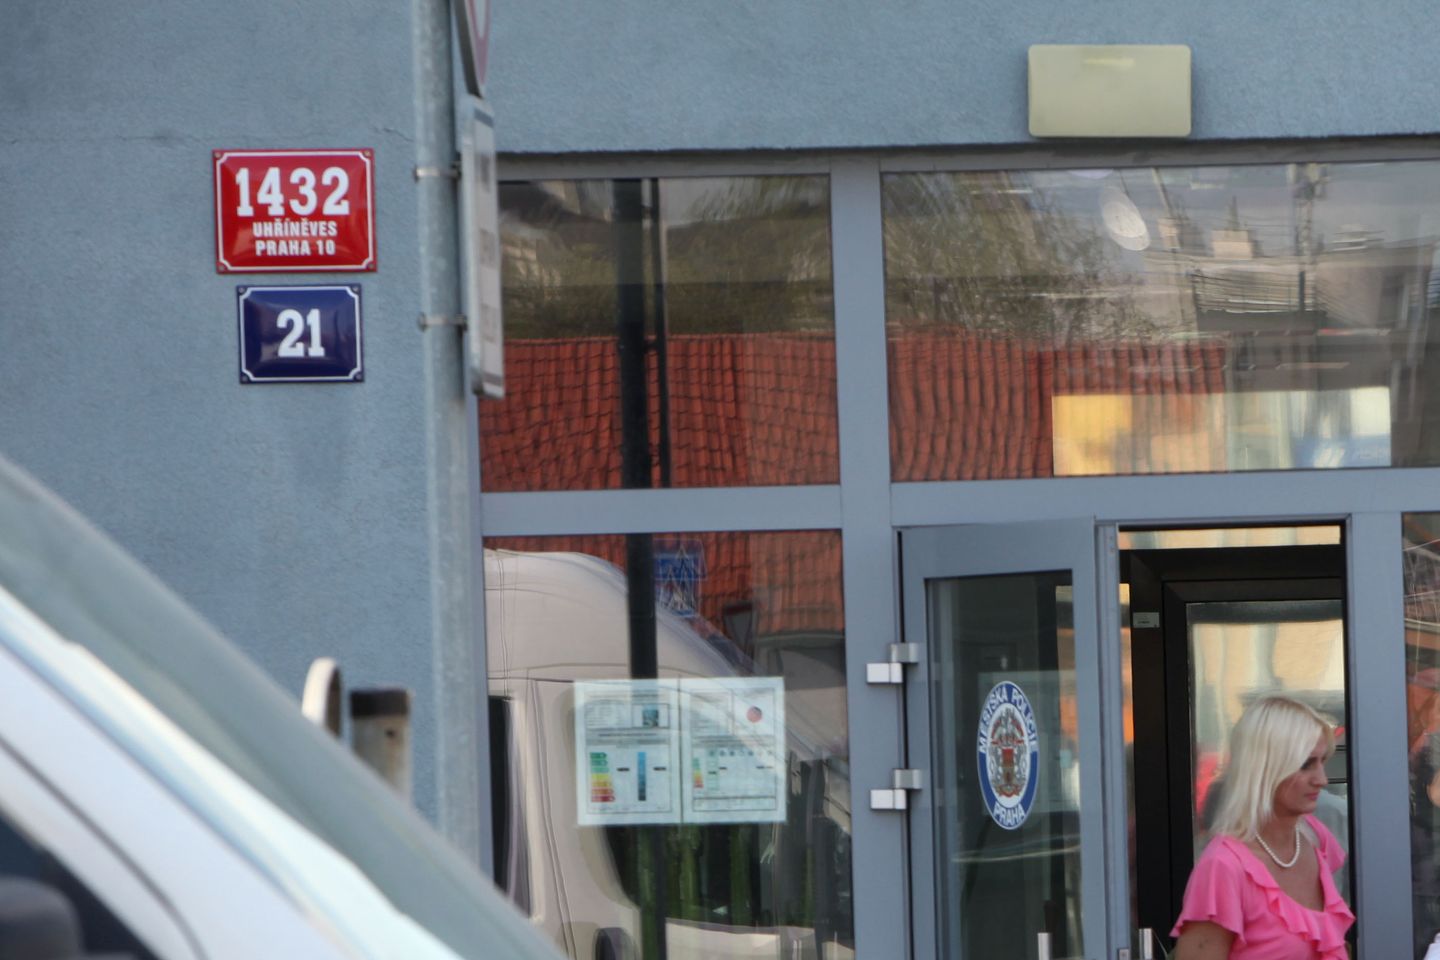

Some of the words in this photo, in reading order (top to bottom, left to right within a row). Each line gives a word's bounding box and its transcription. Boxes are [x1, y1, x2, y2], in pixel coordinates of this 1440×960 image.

[235, 166, 350, 217] 1432
[252, 218, 338, 238] UHŘÍNĚVES
[255, 240, 311, 257] PRAHA
[316, 239, 336, 256] 10
[276, 308, 325, 358] 21
[993, 800, 1026, 827] PRAHA
